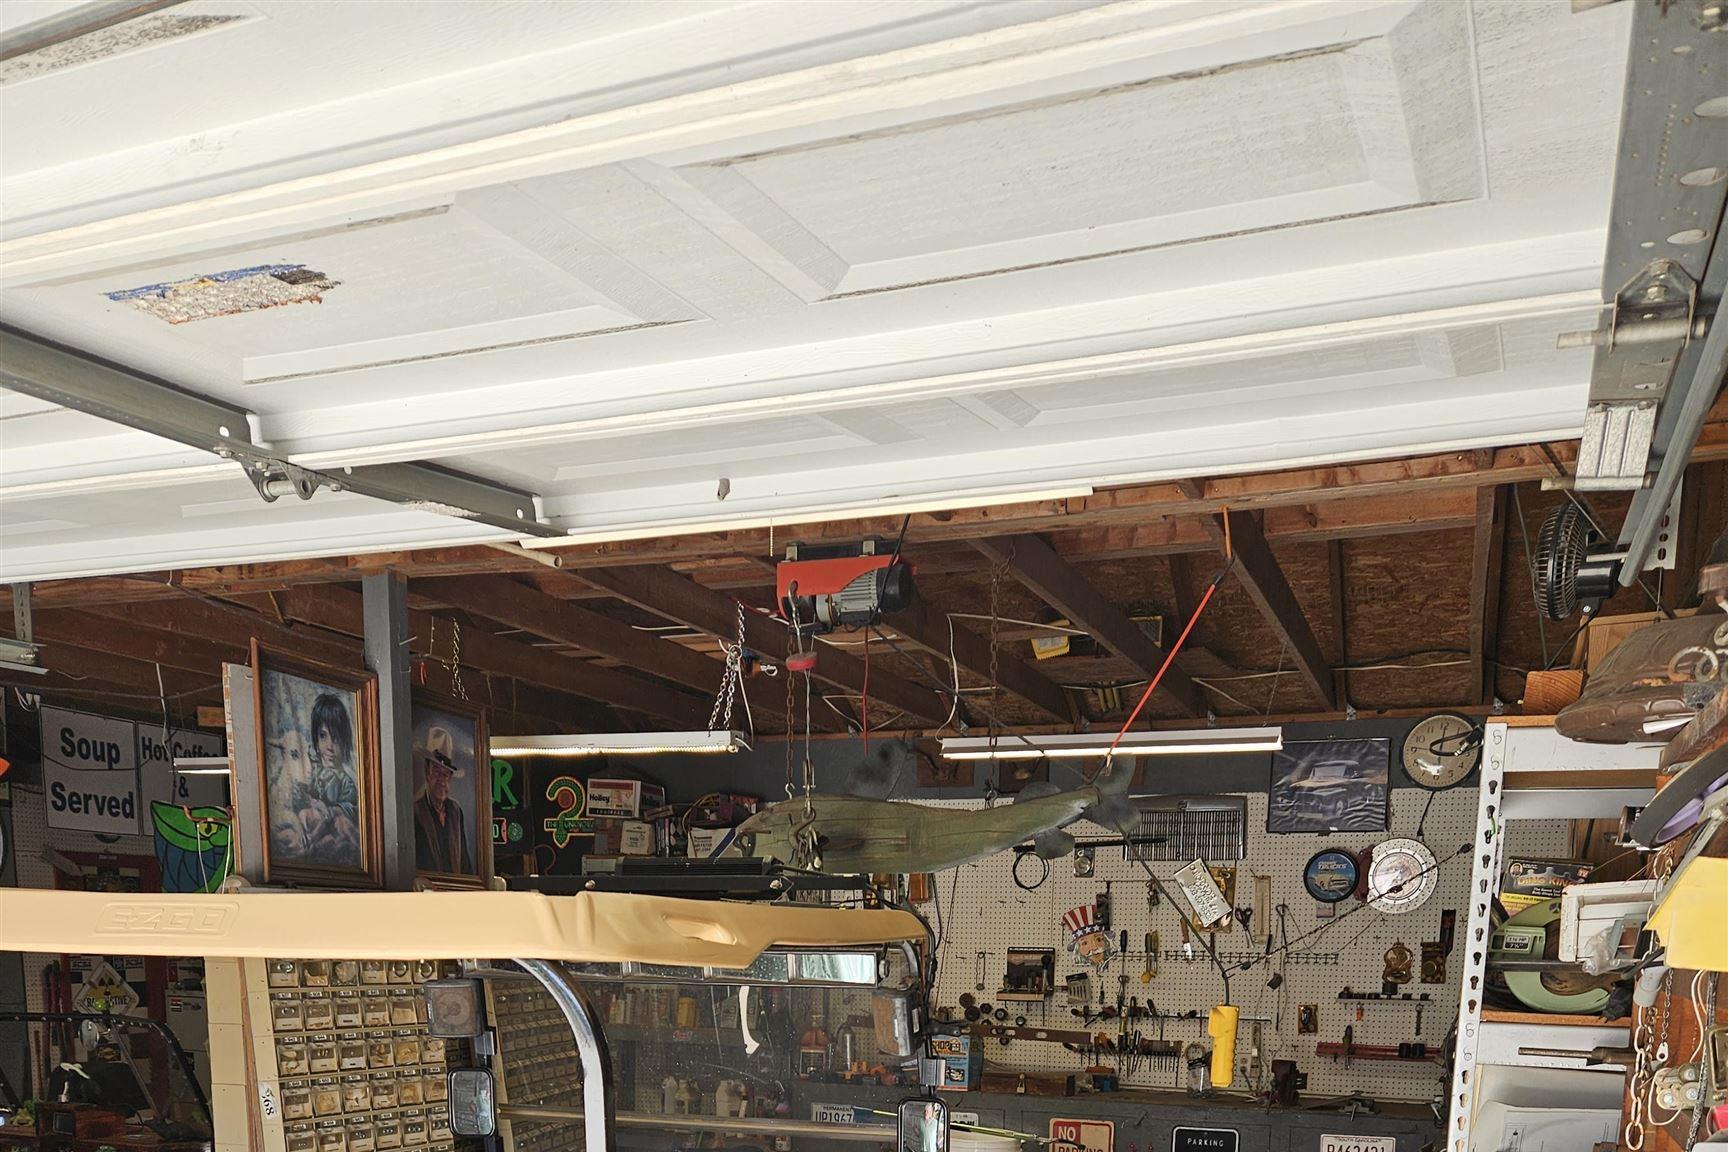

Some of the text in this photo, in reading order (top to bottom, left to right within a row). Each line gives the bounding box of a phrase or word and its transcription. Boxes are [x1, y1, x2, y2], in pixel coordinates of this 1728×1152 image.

[60, 726, 121, 770] Soup
[141, 736, 171, 763] Hot
[178, 776, 189, 799] &
[590, 793, 609, 804] Holley
[50, 781, 135, 819] Served
[1058, 1126, 1076, 1141] NO
[1187, 1138, 1224, 1147] PARKING
